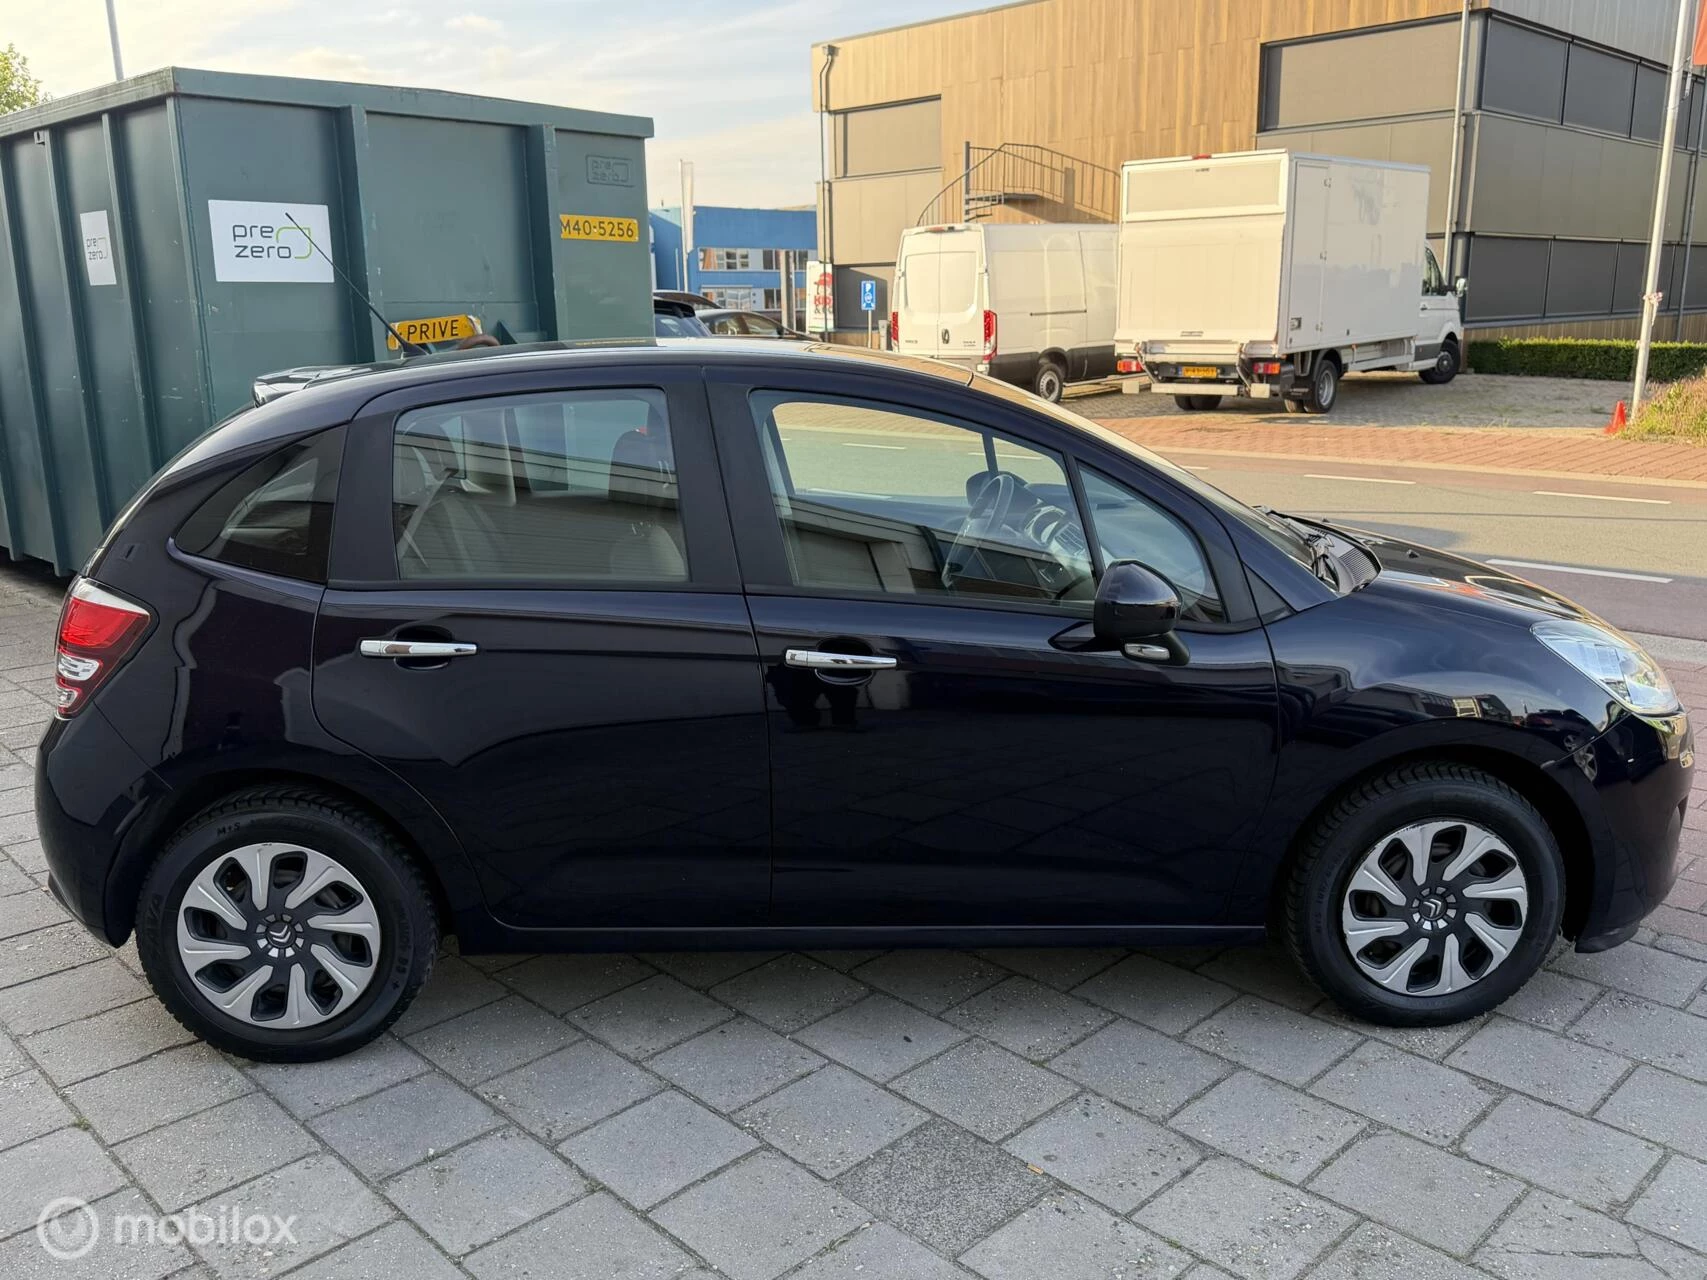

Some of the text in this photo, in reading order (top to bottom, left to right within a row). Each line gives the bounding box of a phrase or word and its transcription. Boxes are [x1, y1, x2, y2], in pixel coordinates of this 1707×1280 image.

[233, 225, 274, 242] pre
[560, 219, 634, 238] M40-5256
[234, 245, 292, 259] zero
[407, 320, 459, 341] PRIVE
